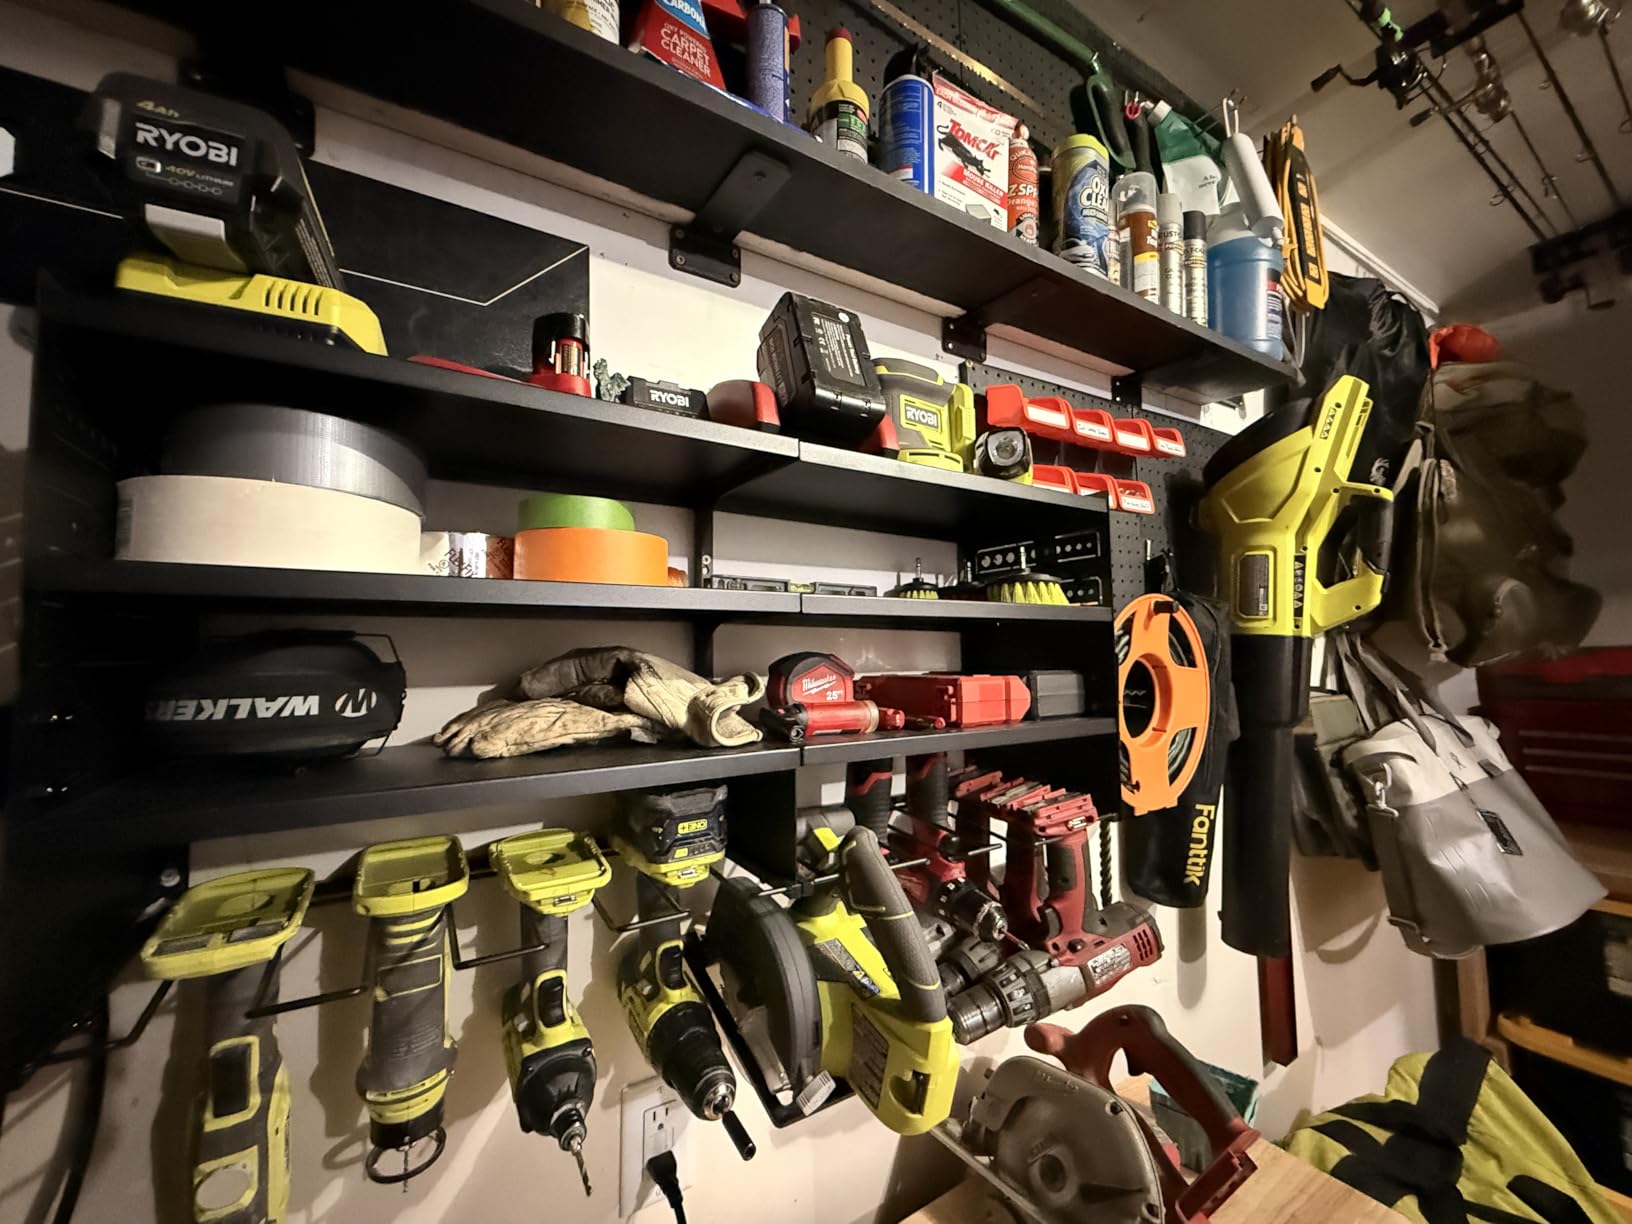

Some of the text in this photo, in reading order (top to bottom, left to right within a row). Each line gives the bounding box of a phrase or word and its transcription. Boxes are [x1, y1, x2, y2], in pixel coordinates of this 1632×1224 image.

[660, 28, 709, 66] CARPET
[660, 39, 711, 79] CLEANER
[135, 121, 238, 166] RYOBI
[949, 118, 1001, 161] TOMCAT
[649, 389, 689, 408] RYOBI
[905, 406, 937, 427] RYOBI
[802, 674, 837, 692] Milwaukee
[1183, 803, 1216, 887] Fanttik
